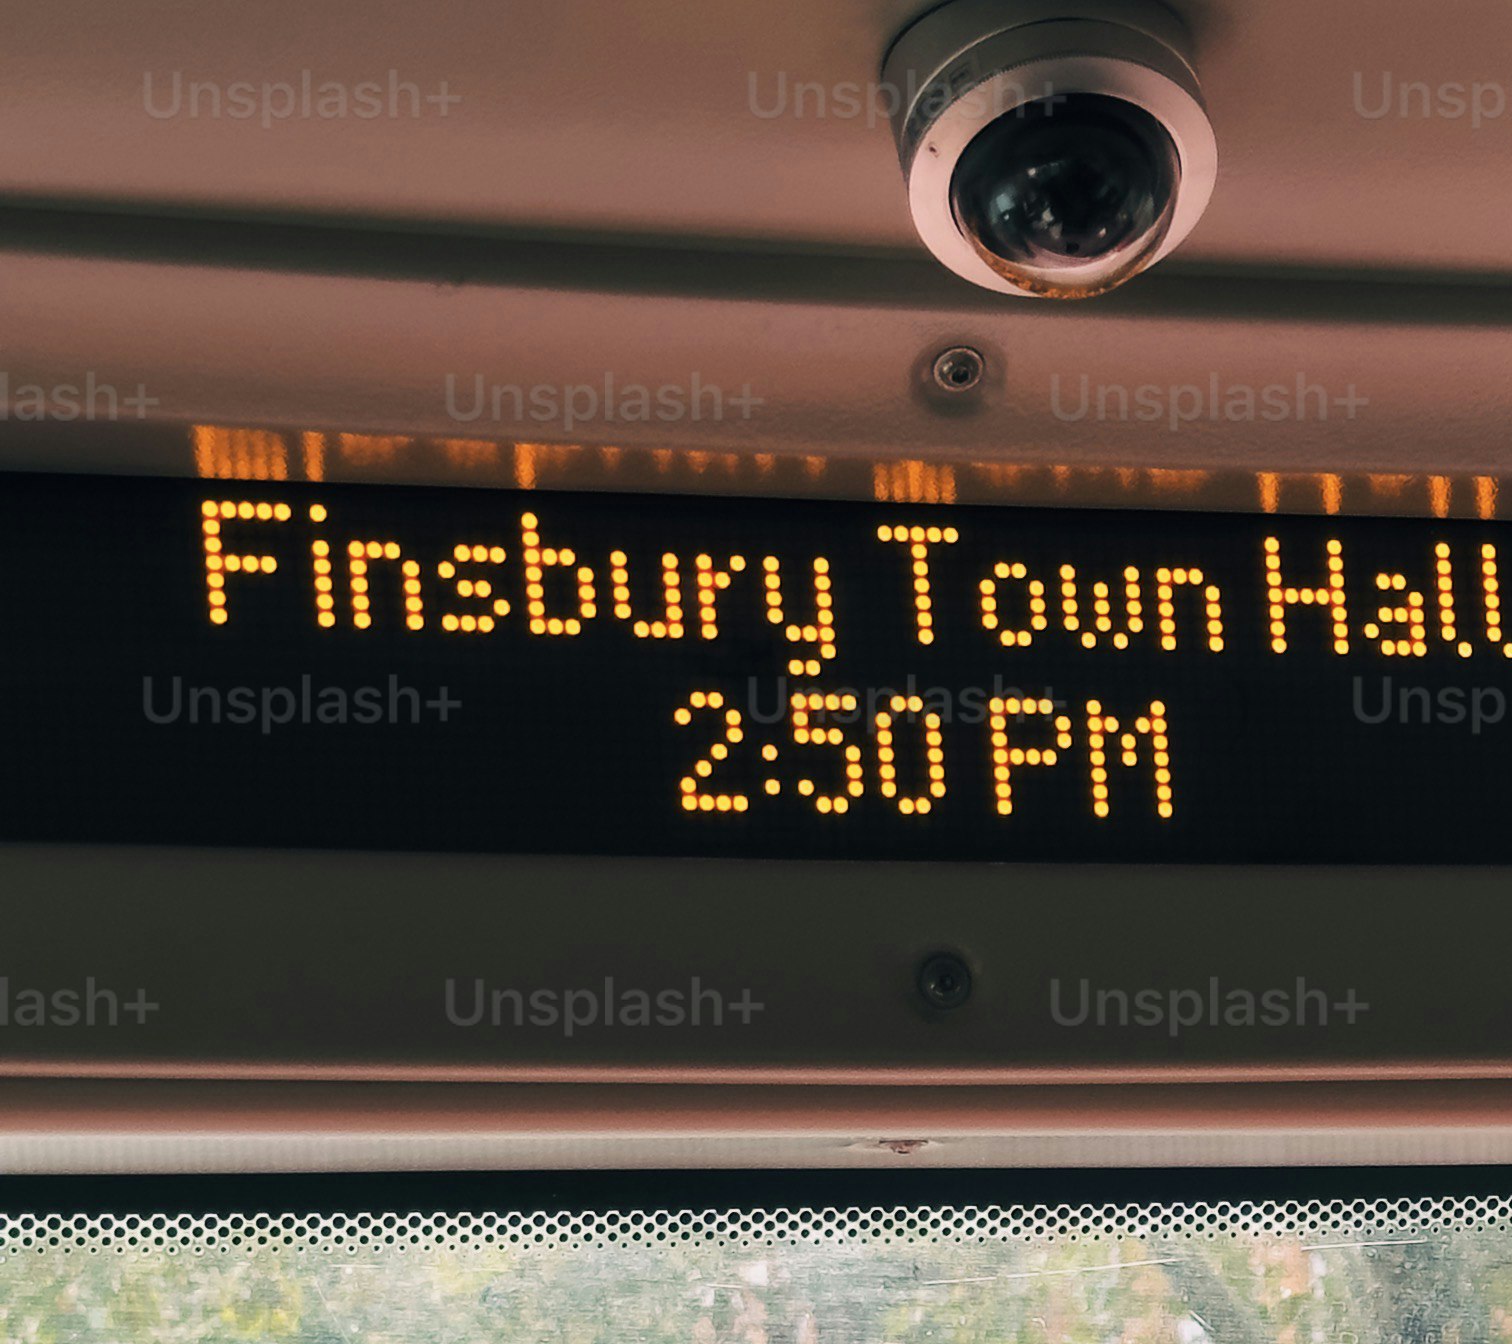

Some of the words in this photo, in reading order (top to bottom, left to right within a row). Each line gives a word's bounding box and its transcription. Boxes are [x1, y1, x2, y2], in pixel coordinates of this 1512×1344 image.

[201, 500, 837, 675] Finsbury
[876, 524, 1225, 652] Town
[673, 690, 947, 815] 2:50
[989, 697, 1175, 819] PM
